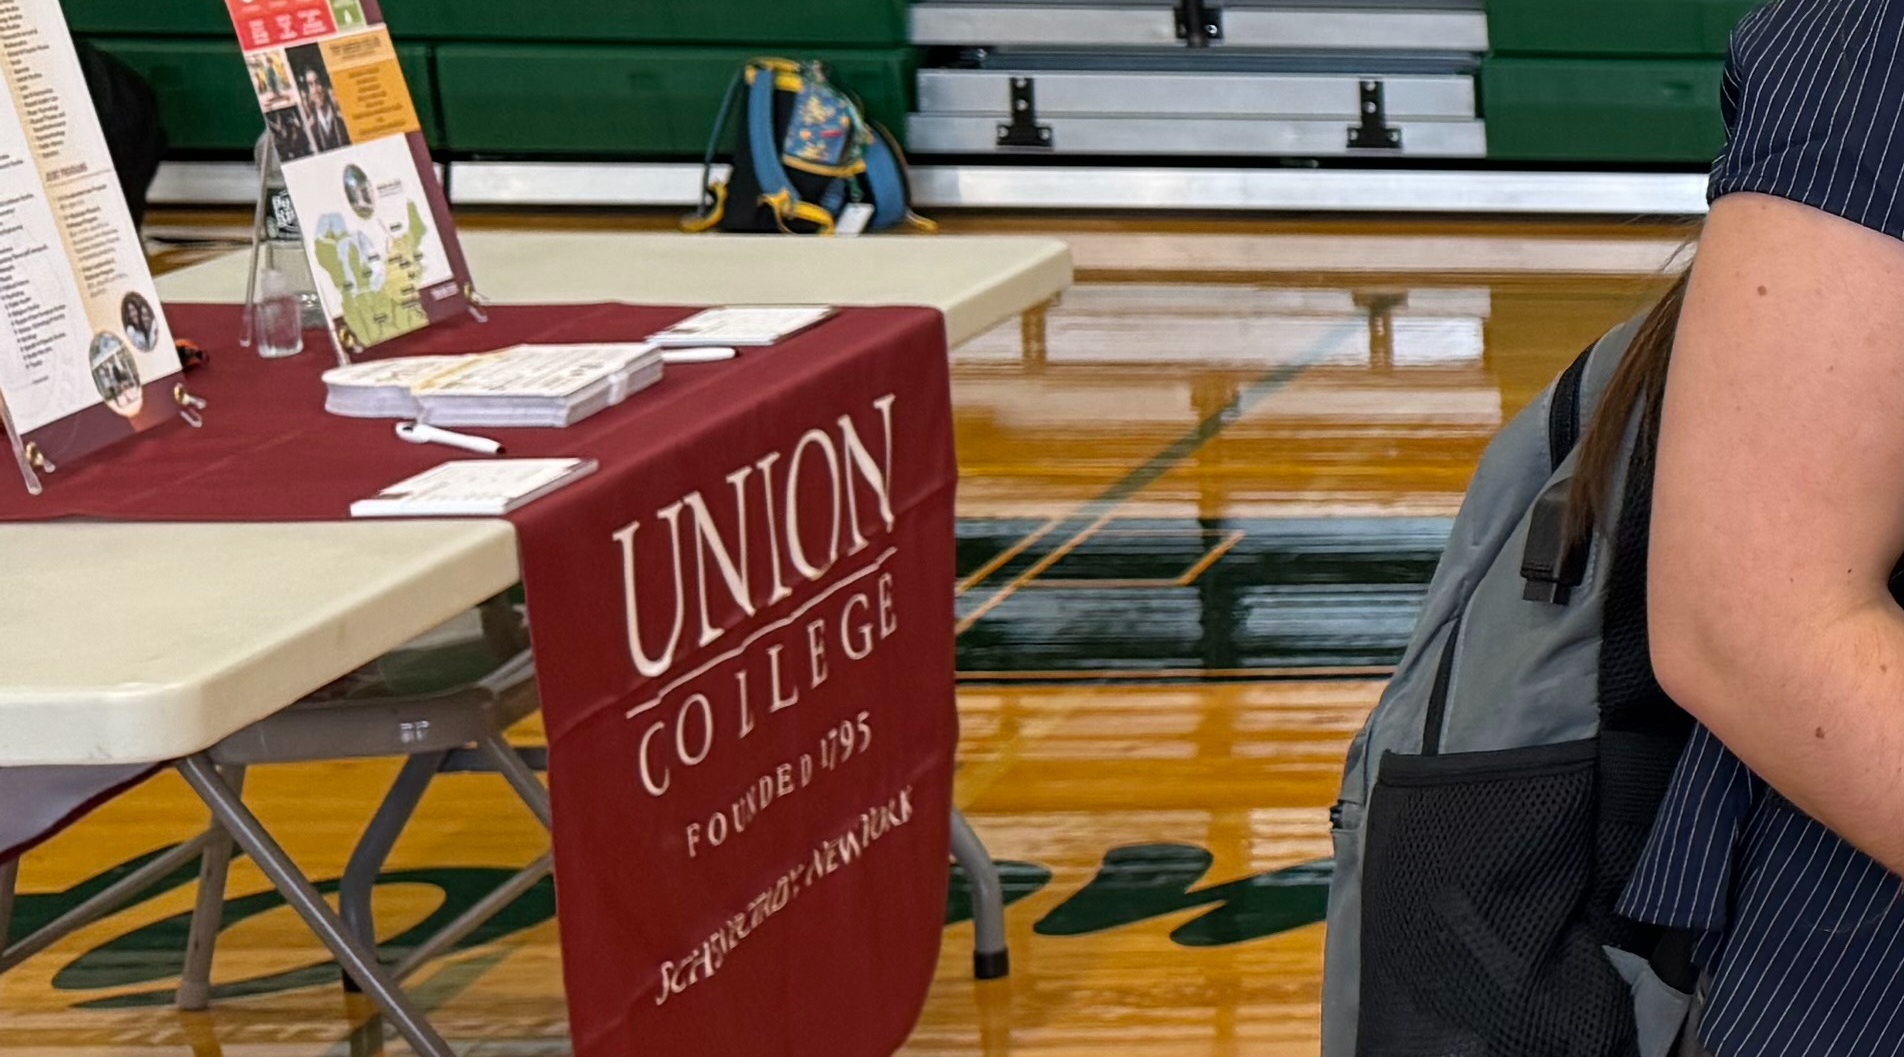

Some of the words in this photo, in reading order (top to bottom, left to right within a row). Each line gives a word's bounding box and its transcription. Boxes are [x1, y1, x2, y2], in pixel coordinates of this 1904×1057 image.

[613, 394, 896, 678] UNION
[686, 753, 813, 857] FOUNDED
[820, 711, 872, 771] 1795
